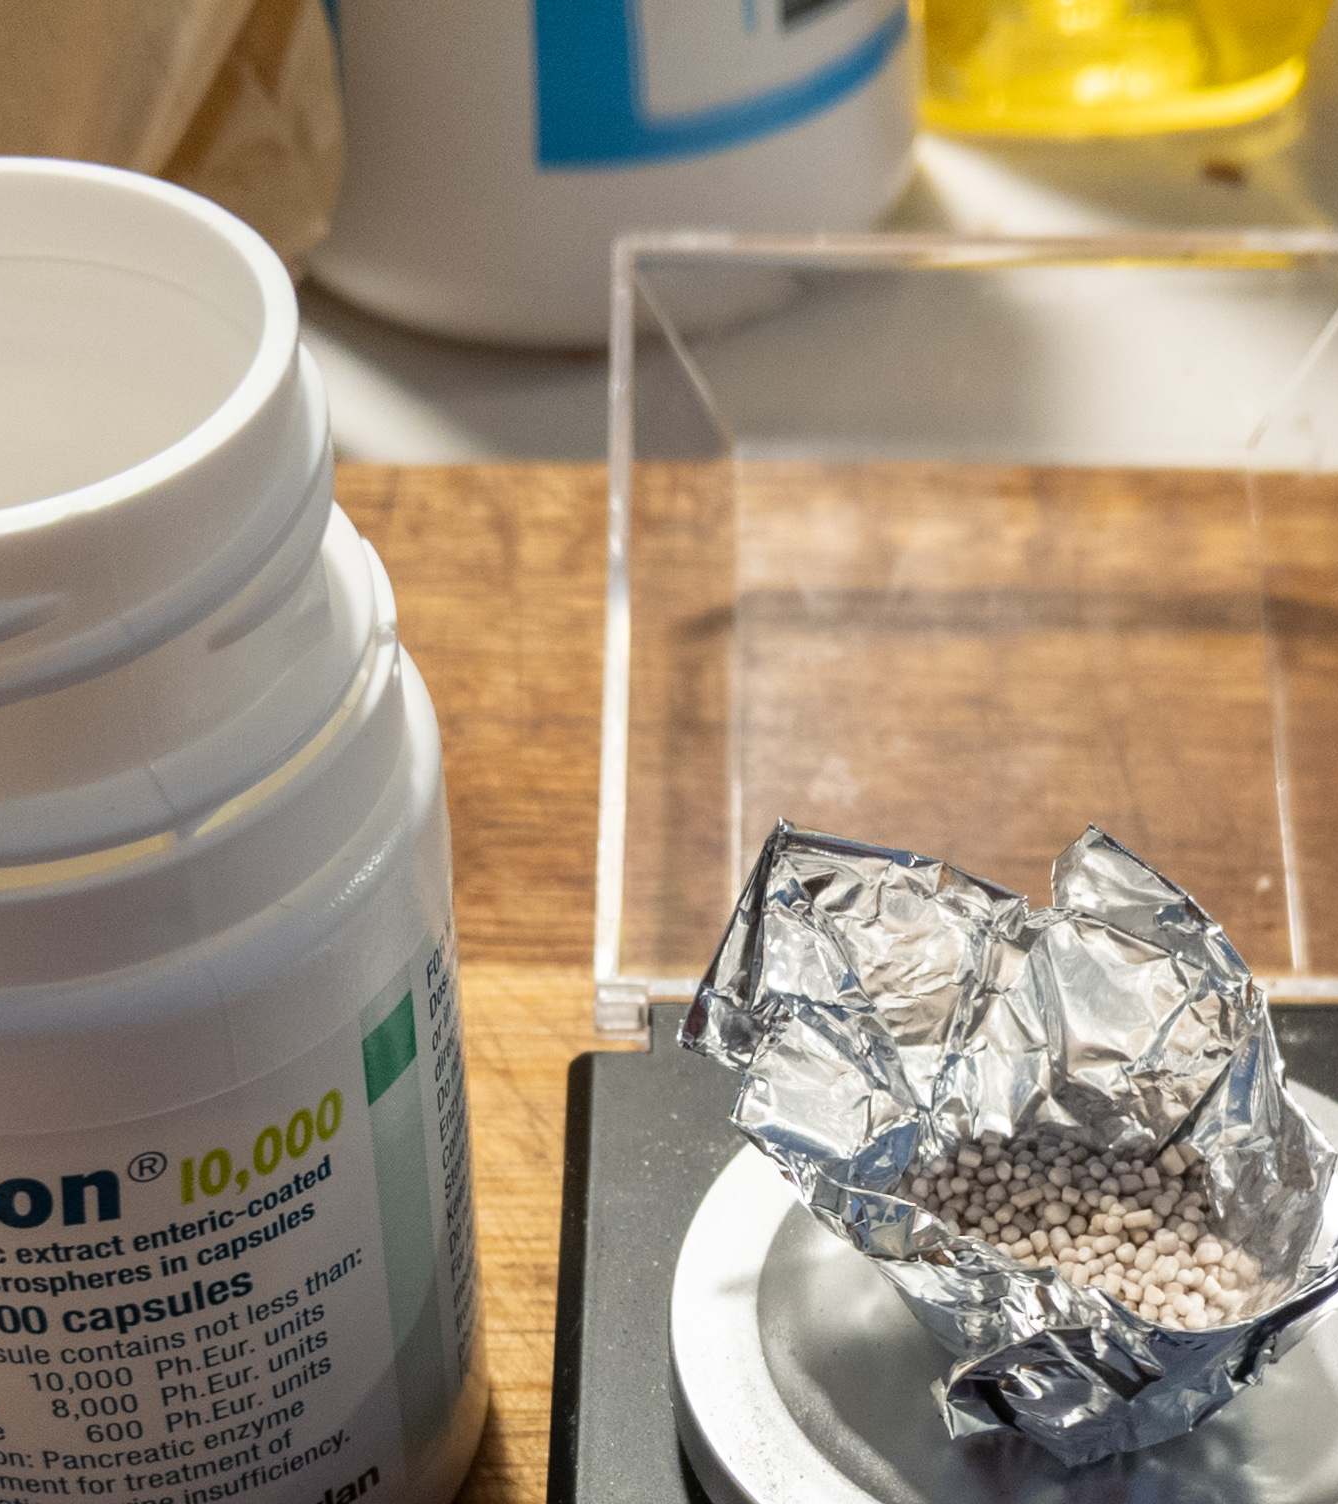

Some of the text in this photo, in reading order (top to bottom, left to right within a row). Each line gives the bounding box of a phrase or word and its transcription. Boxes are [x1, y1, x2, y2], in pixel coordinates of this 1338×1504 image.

[180, 1088, 343, 1206] 10,000
[15, 1235, 125, 1264] extract
[132, 1153, 332, 1253] enteric-coated
[160, 1255, 189, 1278] in
[197, 1202, 316, 1266] capsules
[60, 1331, 186, 1366] contains
[194, 1311, 240, 1343] not
[247, 1288, 300, 1325] less
[305, 1248, 363, 1297] than:
[62, 1271, 254, 1335] capsules
[28, 1366, 134, 1395] 10,000
[155, 1339, 256, 1381] Ph.Eur.
[264, 1303, 326, 1346] units
[52, 1394, 139, 1422] 8,000
[161, 1365, 260, 1407] Ph.Eur.
[268, 1329, 329, 1373] units
[42, 1439, 195, 1471] Pancreatic
[204, 1400, 305, 1450] enzyme
[86, 1420, 144, 1444] 600
[165, 1392, 264, 1434] Ph.Eur.
[272, 1356, 332, 1399] units
[77, 1475, 116, 1496] for
[124, 1445, 262, 1493] treatment
[268, 1428, 294, 1455] of
